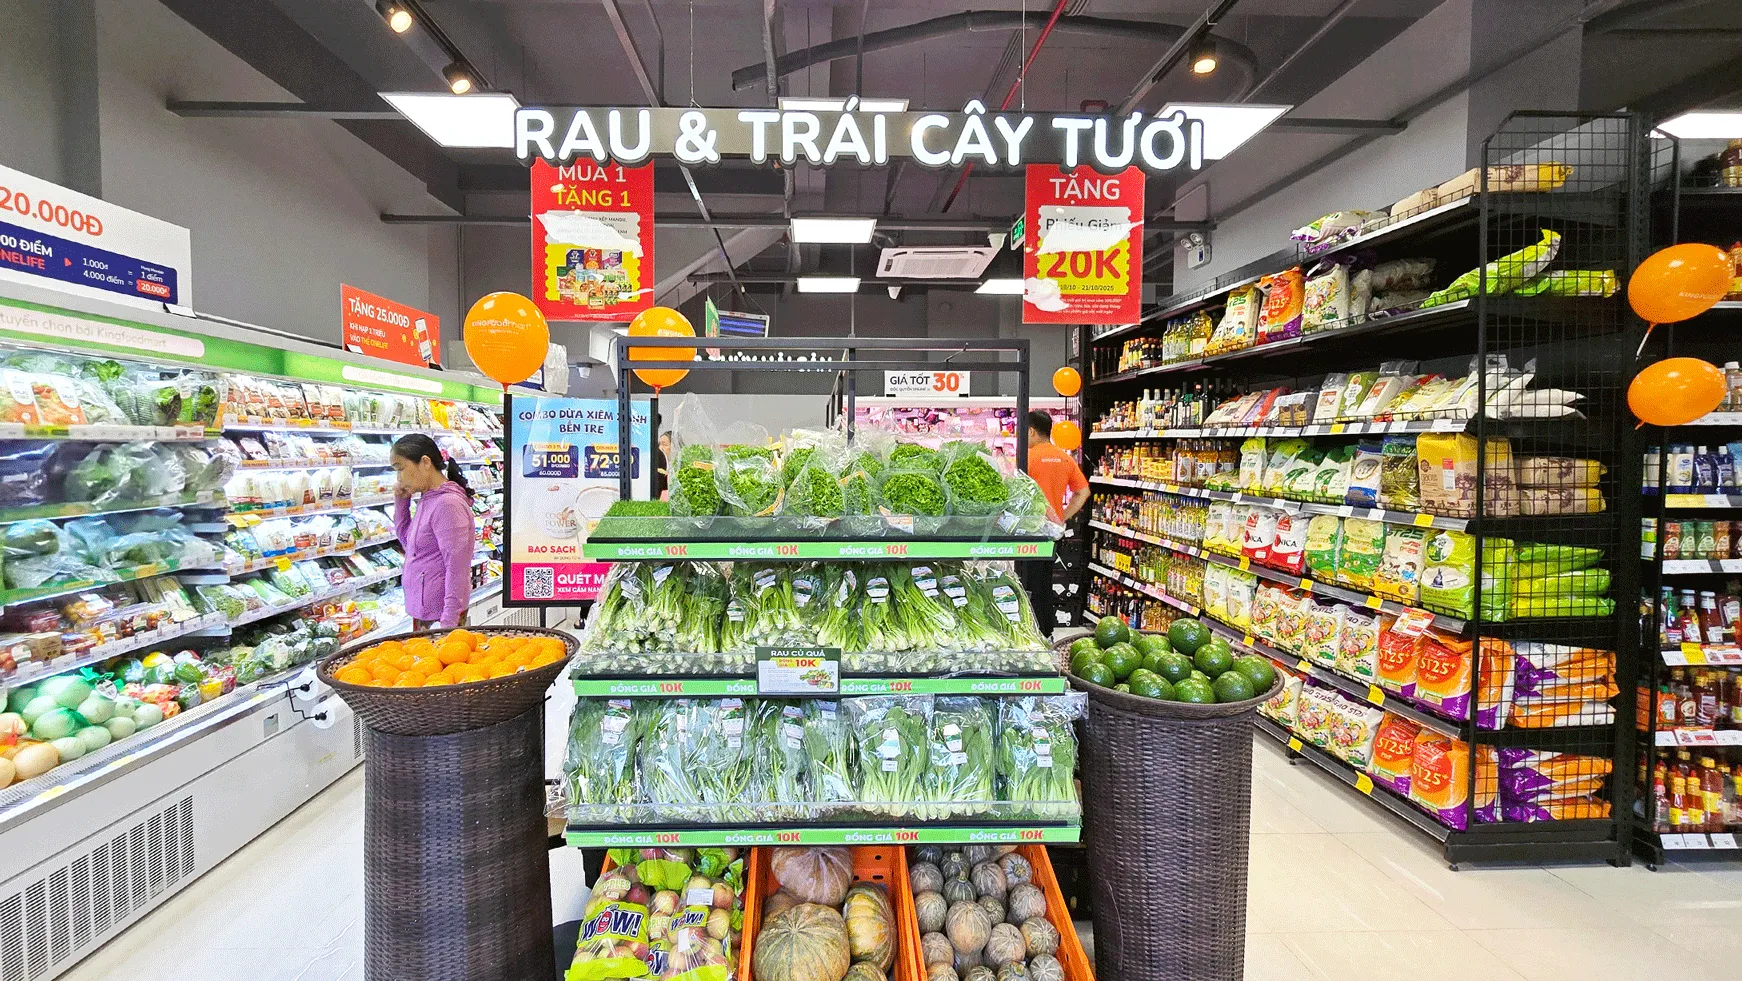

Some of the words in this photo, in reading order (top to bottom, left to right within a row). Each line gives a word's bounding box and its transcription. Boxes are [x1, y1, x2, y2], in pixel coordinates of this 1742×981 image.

[515, 109, 651, 160] RAU
[674, 111, 720, 161] &
[737, 96, 886, 164] TRÁI
[910, 99, 1034, 166] CÂY
[1051, 111, 1202, 170] TƯƠI
[558, 165, 608, 181] MUA
[615, 166, 627, 182] 1
[1049, 173, 1120, 204] TẶNG
[555, 185, 612, 209] TẶNG
[620, 191, 631, 206] 1
[0, 185, 104, 237] 20.000Đ
[19, 238, 53, 258] ĐIỂM
[0, 250, 46, 270] NELIFE
[1046, 248, 1121, 279] 20K
[83, 269, 105, 281] 4.000
[348, 296, 375, 318] TẶNG
[376, 307, 410, 328] 25.000Đ
[349, 322, 358, 331] KHI
[358, 324, 369, 334] NẠP
[890, 374, 908, 385] GIÁ
[910, 372, 930, 385] TỐT
[559, 408, 583, 420] DỪA
[587, 410, 614, 421] XIÊM
[559, 421, 581, 433] BẾN
[584, 424, 605, 434] TRE
[531, 454, 571, 467] 51.000
[550, 546, 576, 555] SẠCH
[617, 544, 645, 556] ĐỒNG
[646, 545, 663, 556] GIÁ
[665, 545, 688, 556] 10K
[729, 544, 756, 556] ĐỒNG
[757, 545, 774, 555] GIÁ
[776, 544, 799, 555] 10K
[839, 545, 866, 555] ĐỒNG
[867, 545, 883, 555] GIÁ
[886, 545, 908, 555] 10K
[970, 544, 996, 555] ĐỒNG
[998, 545, 1013, 554] GIÁ
[1016, 545, 1038, 554] 10K
[557, 572, 592, 585] QUÉT
[594, 574, 605, 585] M
[791, 648, 804, 657] CỦ
[806, 648, 826, 657] QUẢ
[1378, 648, 1410, 664] ST25+
[795, 659, 816, 667] 10K
[1420, 657, 1457, 676] ST25+
[610, 682, 637, 693] ĐỒNG
[638, 683, 657, 693] GIÁ
[659, 682, 683, 693] 10K
[841, 682, 869, 692] ĐỒNG
[870, 682, 887, 692] GIÁ
[889, 682, 912, 691] 10K
[971, 681, 998, 691] ĐỒNG
[999, 681, 1016, 691] GIÁ
[1019, 681, 1042, 690] 10K
[1412, 764, 1450, 786] ST25+
[603, 834, 634, 844] ĐỒNG
[635, 835, 653, 843] GIÁ
[655, 834, 680, 843] 10K
[725, 834, 754, 843] ĐỒNG
[756, 833, 773, 843] GIÁ
[776, 832, 801, 842] 10K
[845, 832, 874, 842] ĐỒNG
[875, 832, 892, 841] GIÁ
[895, 831, 919, 841] 10K
[969, 831, 998, 841] ĐỒNG
[999, 832, 1016, 841] GIÁ
[1019, 830, 1044, 840] 10K
[580, 908, 644, 941] WOW!
[670, 910, 705, 932] WOW!
